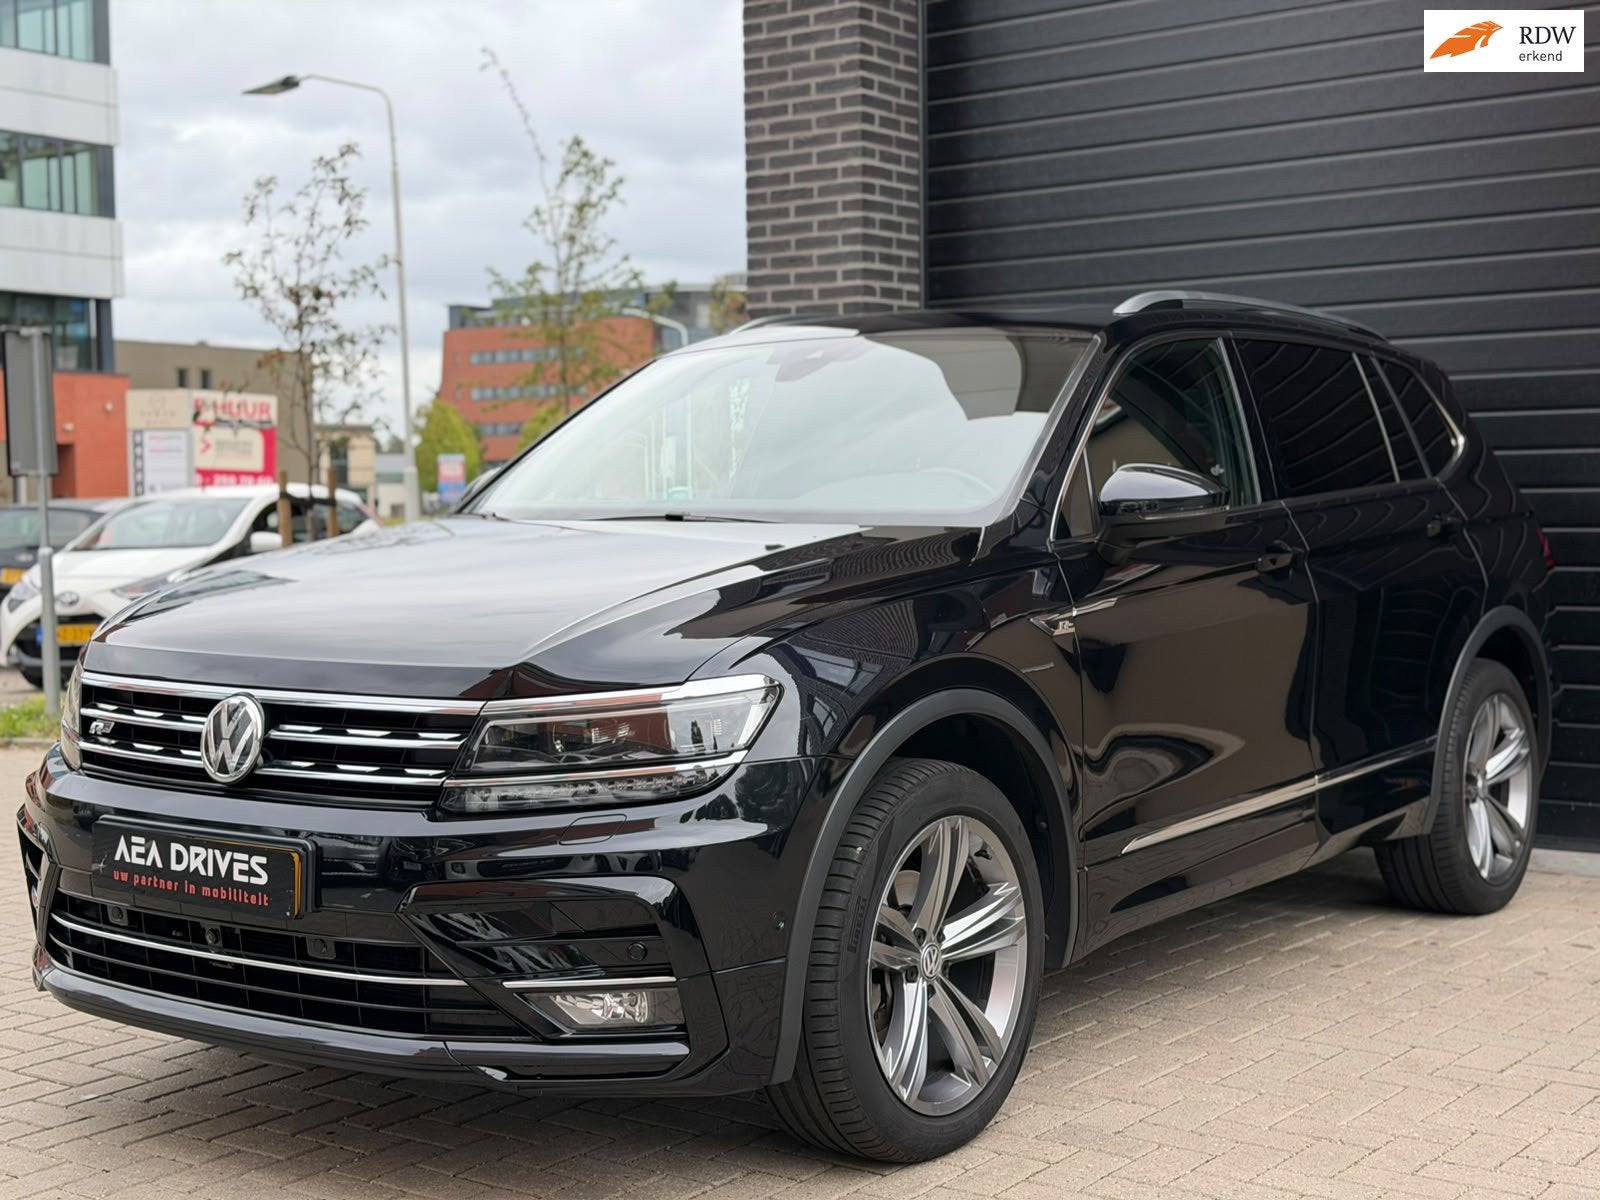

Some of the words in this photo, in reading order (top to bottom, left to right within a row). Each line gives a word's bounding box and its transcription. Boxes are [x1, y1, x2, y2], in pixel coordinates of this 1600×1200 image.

[114, 834, 163, 869] AEA
[170, 842, 269, 886] DRIVES
[113, 870, 129, 882] uw
[133, 872, 179, 892] partner
[184, 880, 196, 895] in
[201, 885, 269, 907] mobiliteit
